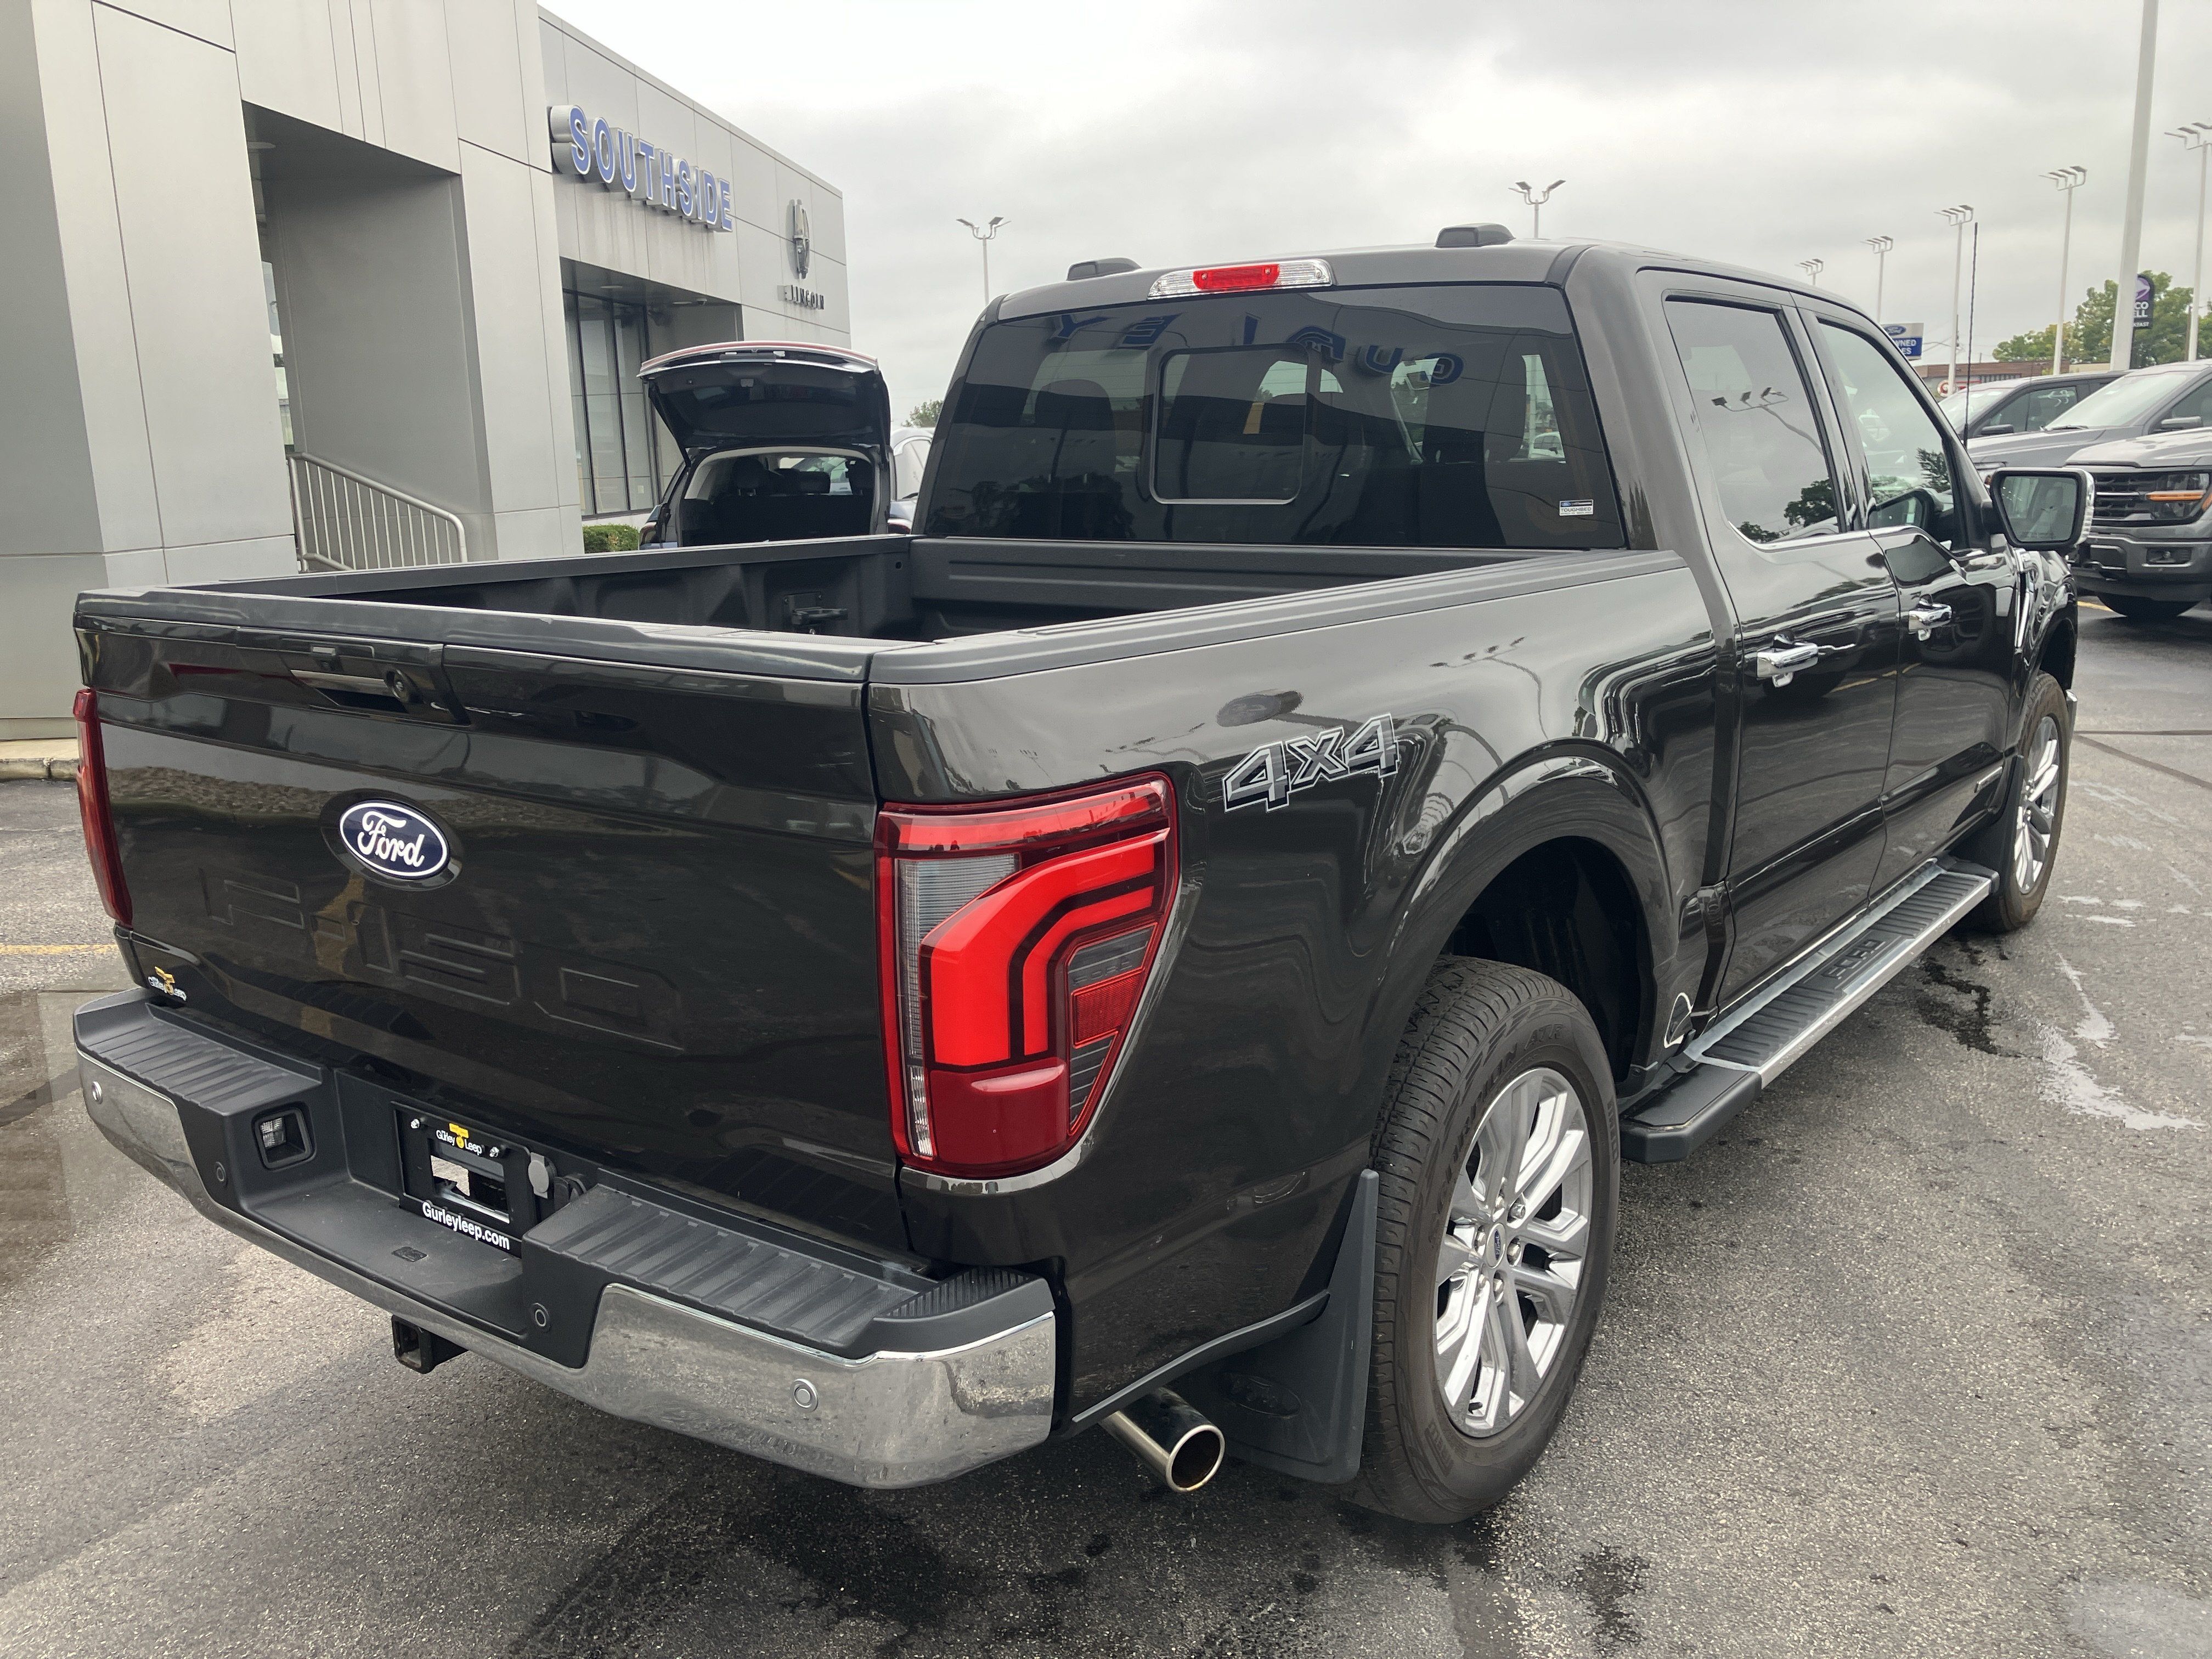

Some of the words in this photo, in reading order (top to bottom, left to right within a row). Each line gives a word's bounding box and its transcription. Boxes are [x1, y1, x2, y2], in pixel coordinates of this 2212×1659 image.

[568, 104, 733, 233] SOUTHSIDE
[2135, 302, 2149, 310] CO
[1894, 339, 1917, 347] WNED
[357, 810, 426, 867] Ford
[436, 1129, 455, 1146] Gurley
[465, 1139, 482, 1155] Leep
[422, 1201, 510, 1250] Gurleyleep.com
